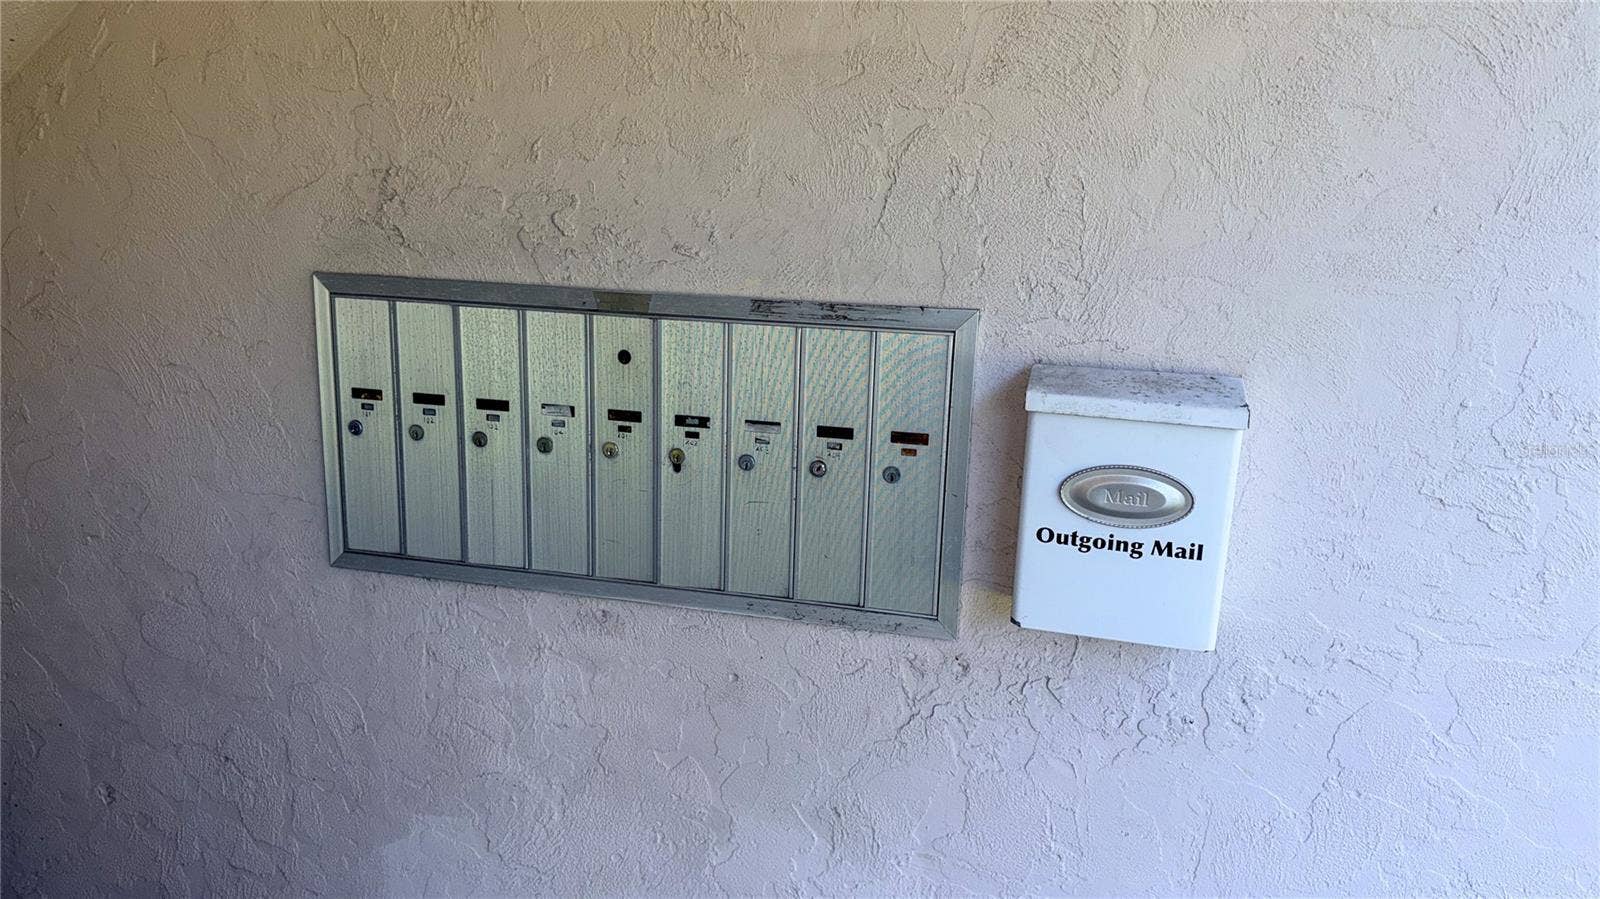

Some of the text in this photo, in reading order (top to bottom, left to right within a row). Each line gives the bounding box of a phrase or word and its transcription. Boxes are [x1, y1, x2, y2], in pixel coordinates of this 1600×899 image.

[1103, 488, 1149, 508] Mail
[1036, 526, 1204, 561] Outgoing Mail
